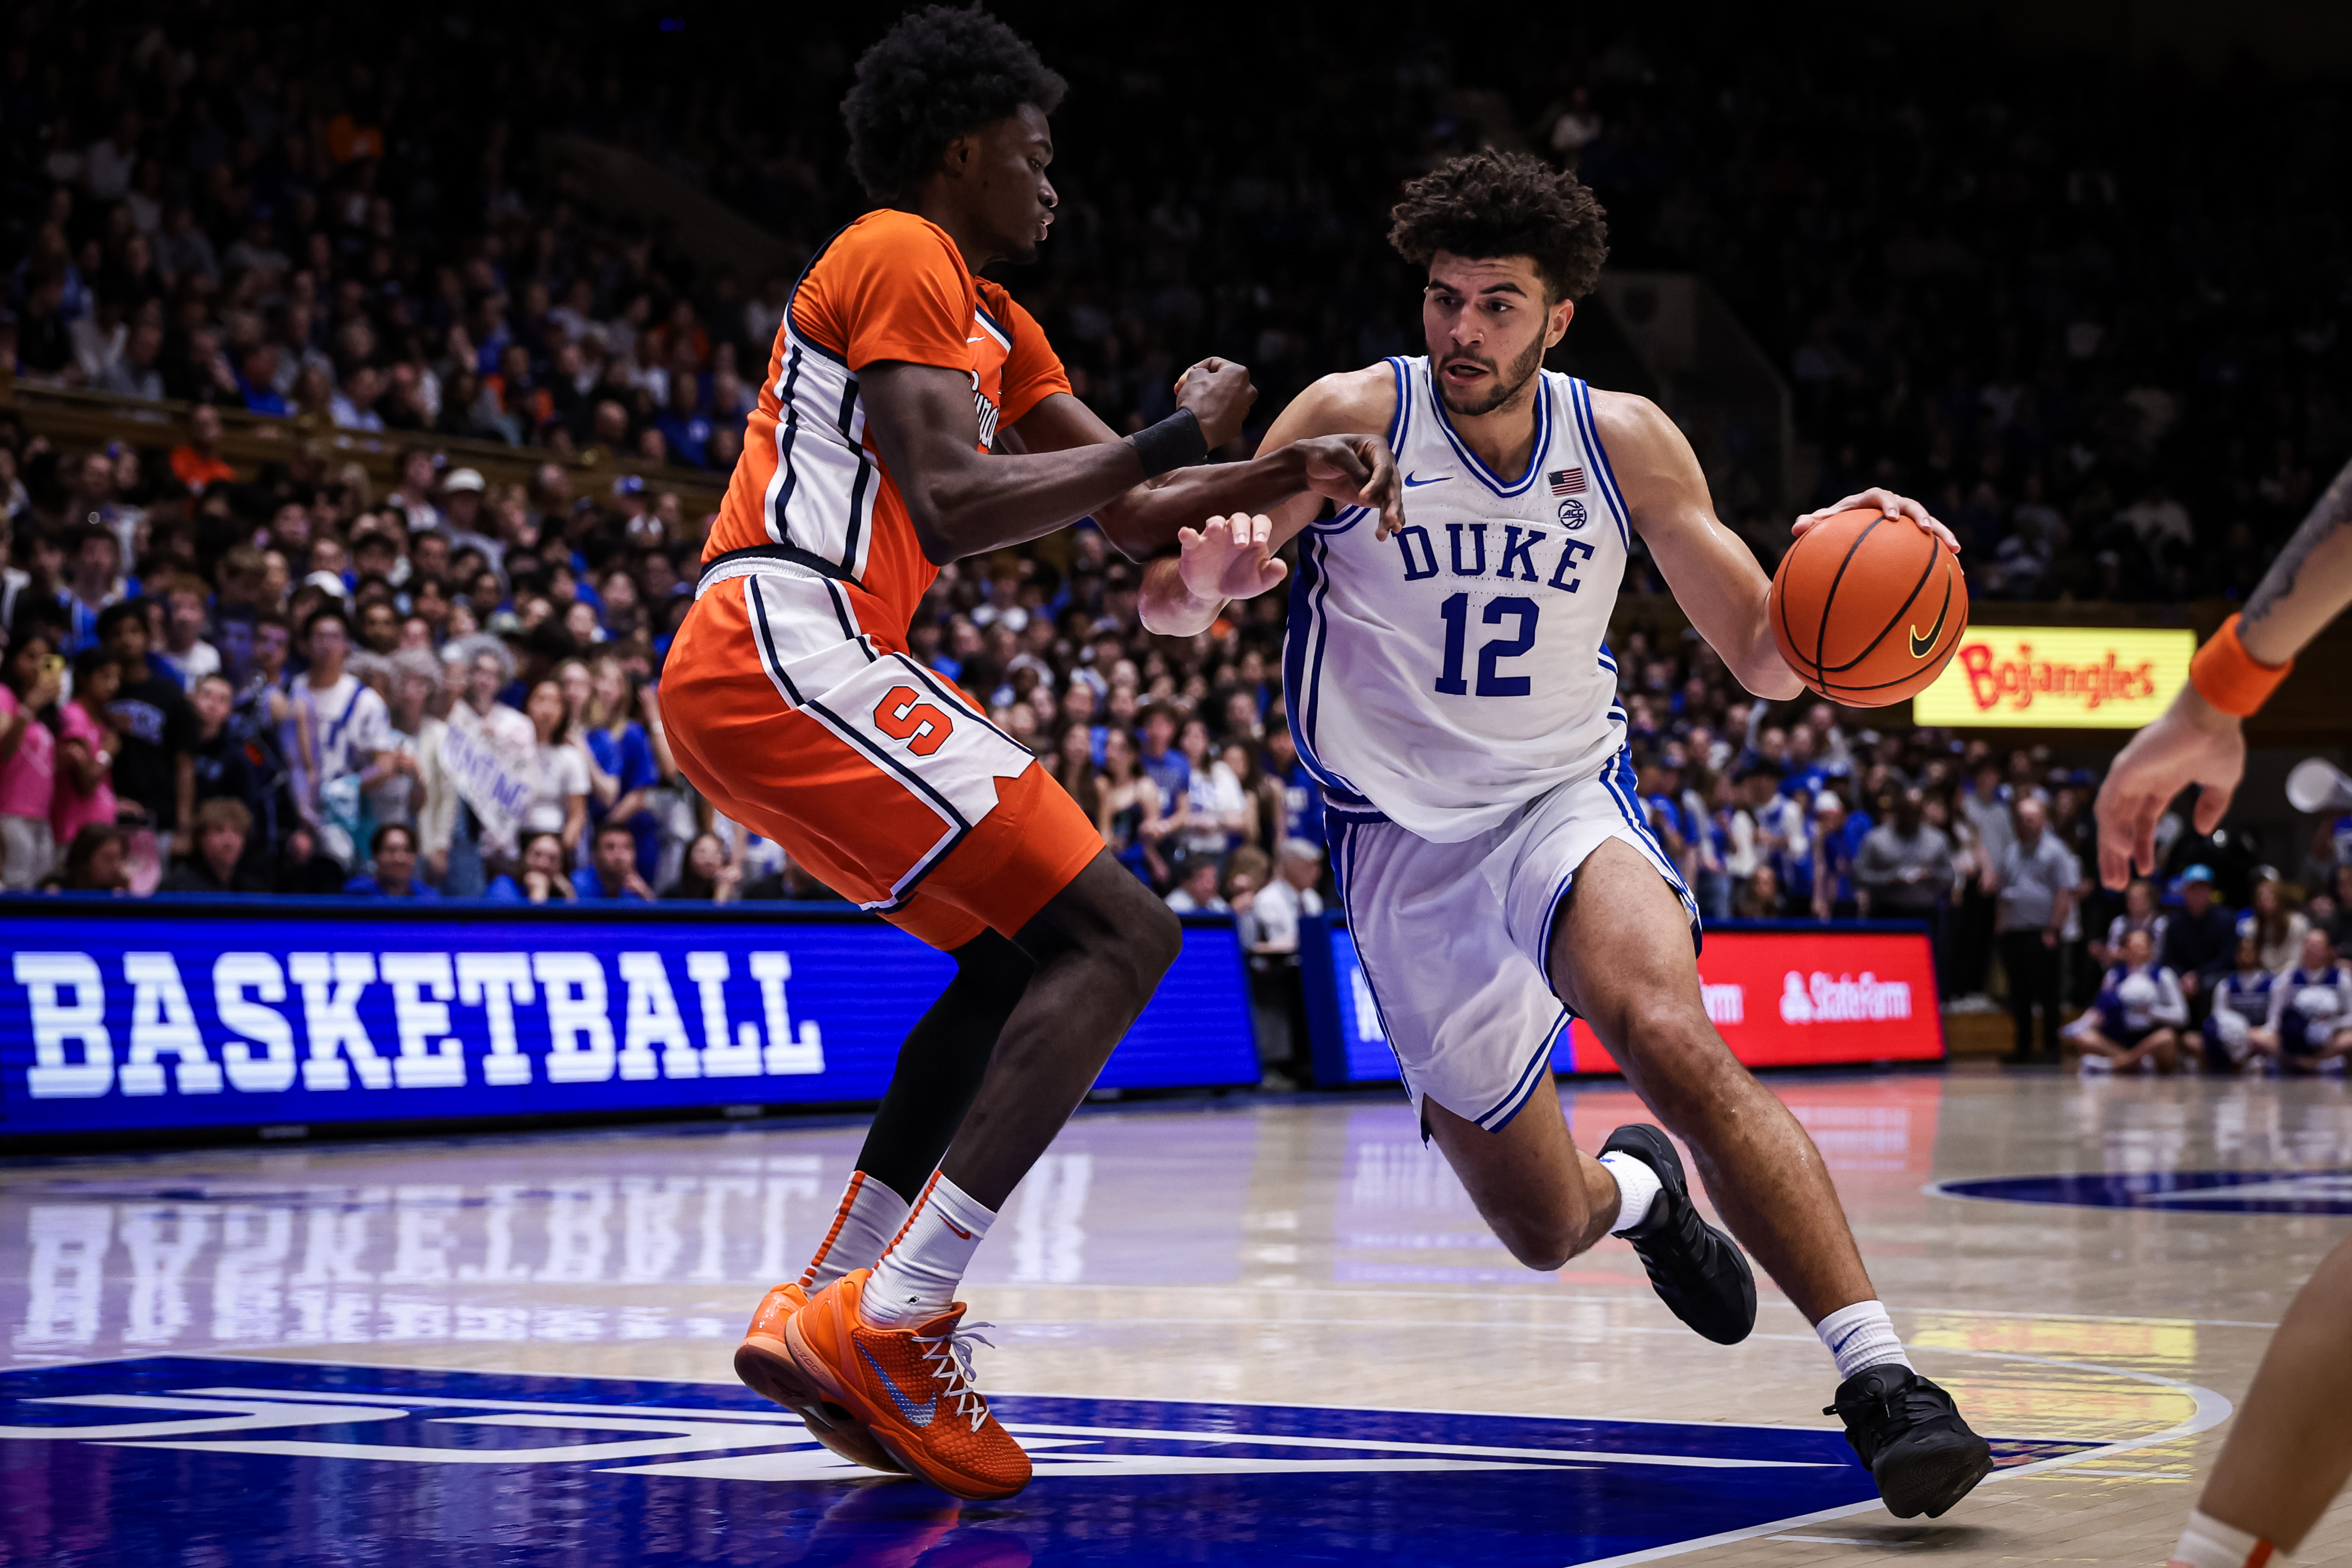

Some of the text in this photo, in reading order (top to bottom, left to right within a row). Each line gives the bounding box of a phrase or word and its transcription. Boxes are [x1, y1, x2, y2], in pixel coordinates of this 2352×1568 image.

[1562, 508, 1584, 517] ACC
[1391, 523, 1596, 594] DUKE
[1435, 592, 1540, 697] 12
[1959, 644, 2154, 711] Bojangles
[872, 685, 955, 757] S
[12, 950, 826, 1099] BASKETBALL
